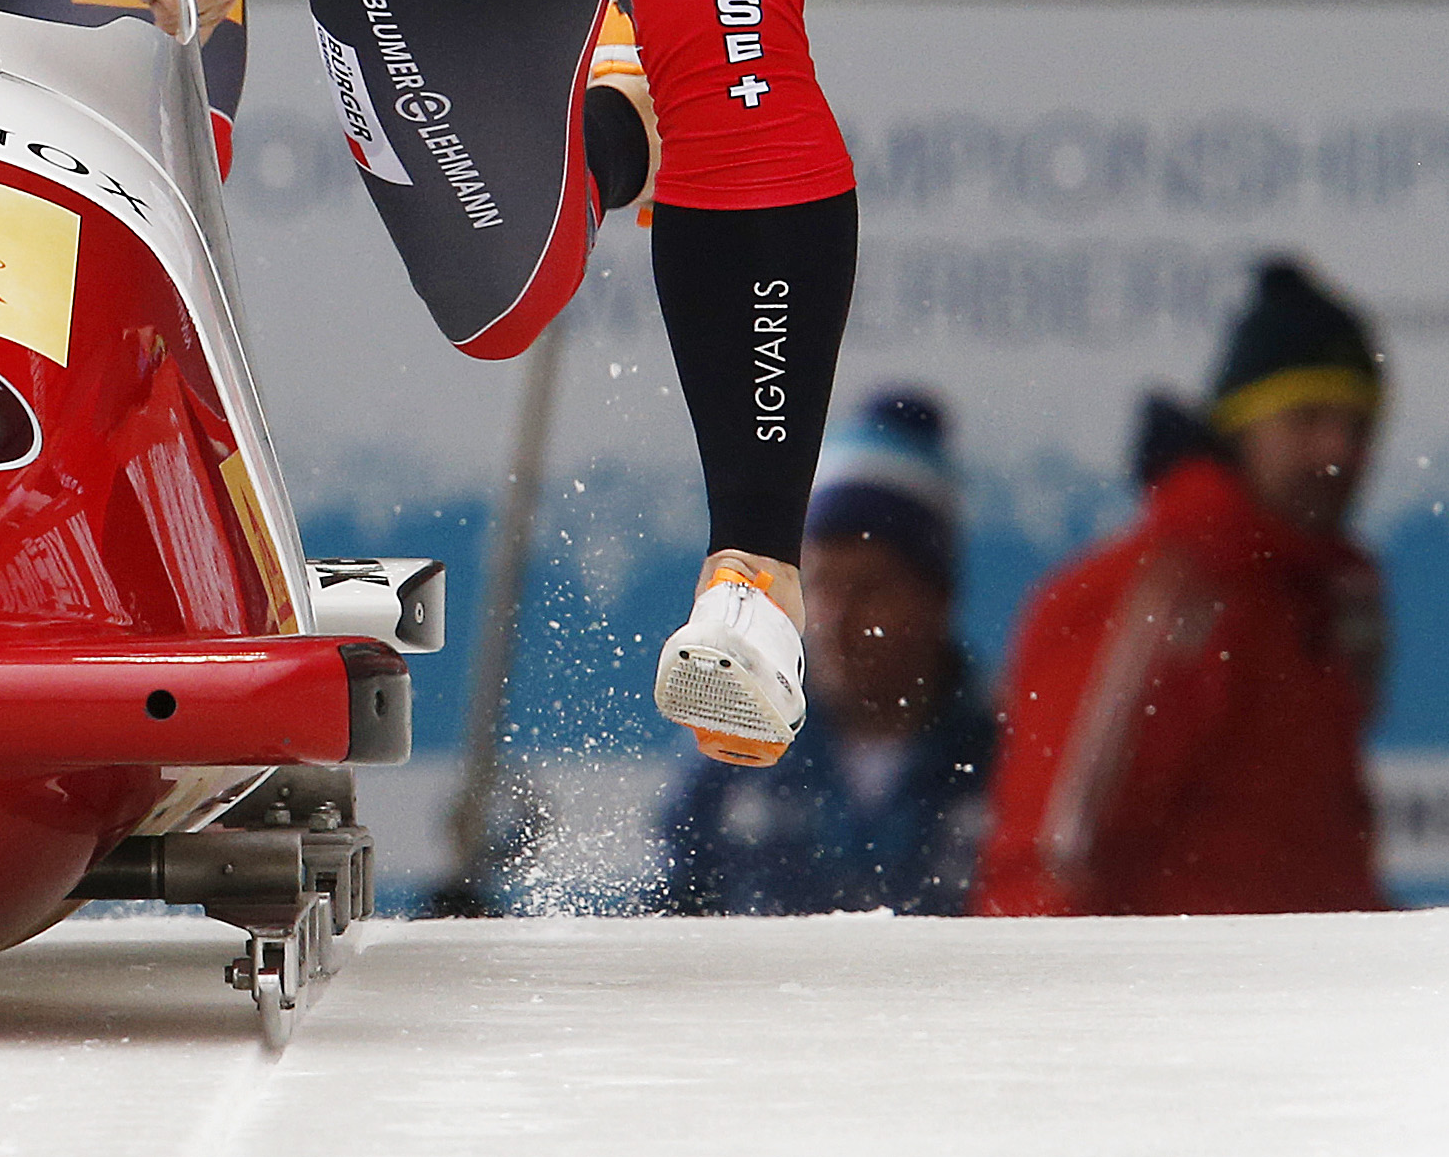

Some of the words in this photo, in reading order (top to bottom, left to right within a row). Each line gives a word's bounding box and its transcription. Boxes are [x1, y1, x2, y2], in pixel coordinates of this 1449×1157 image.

[327, 37, 373, 142] BÜRGER
[417, 123, 504, 229] LEHMANN
[753, 280, 790, 443] SIGVARIS
